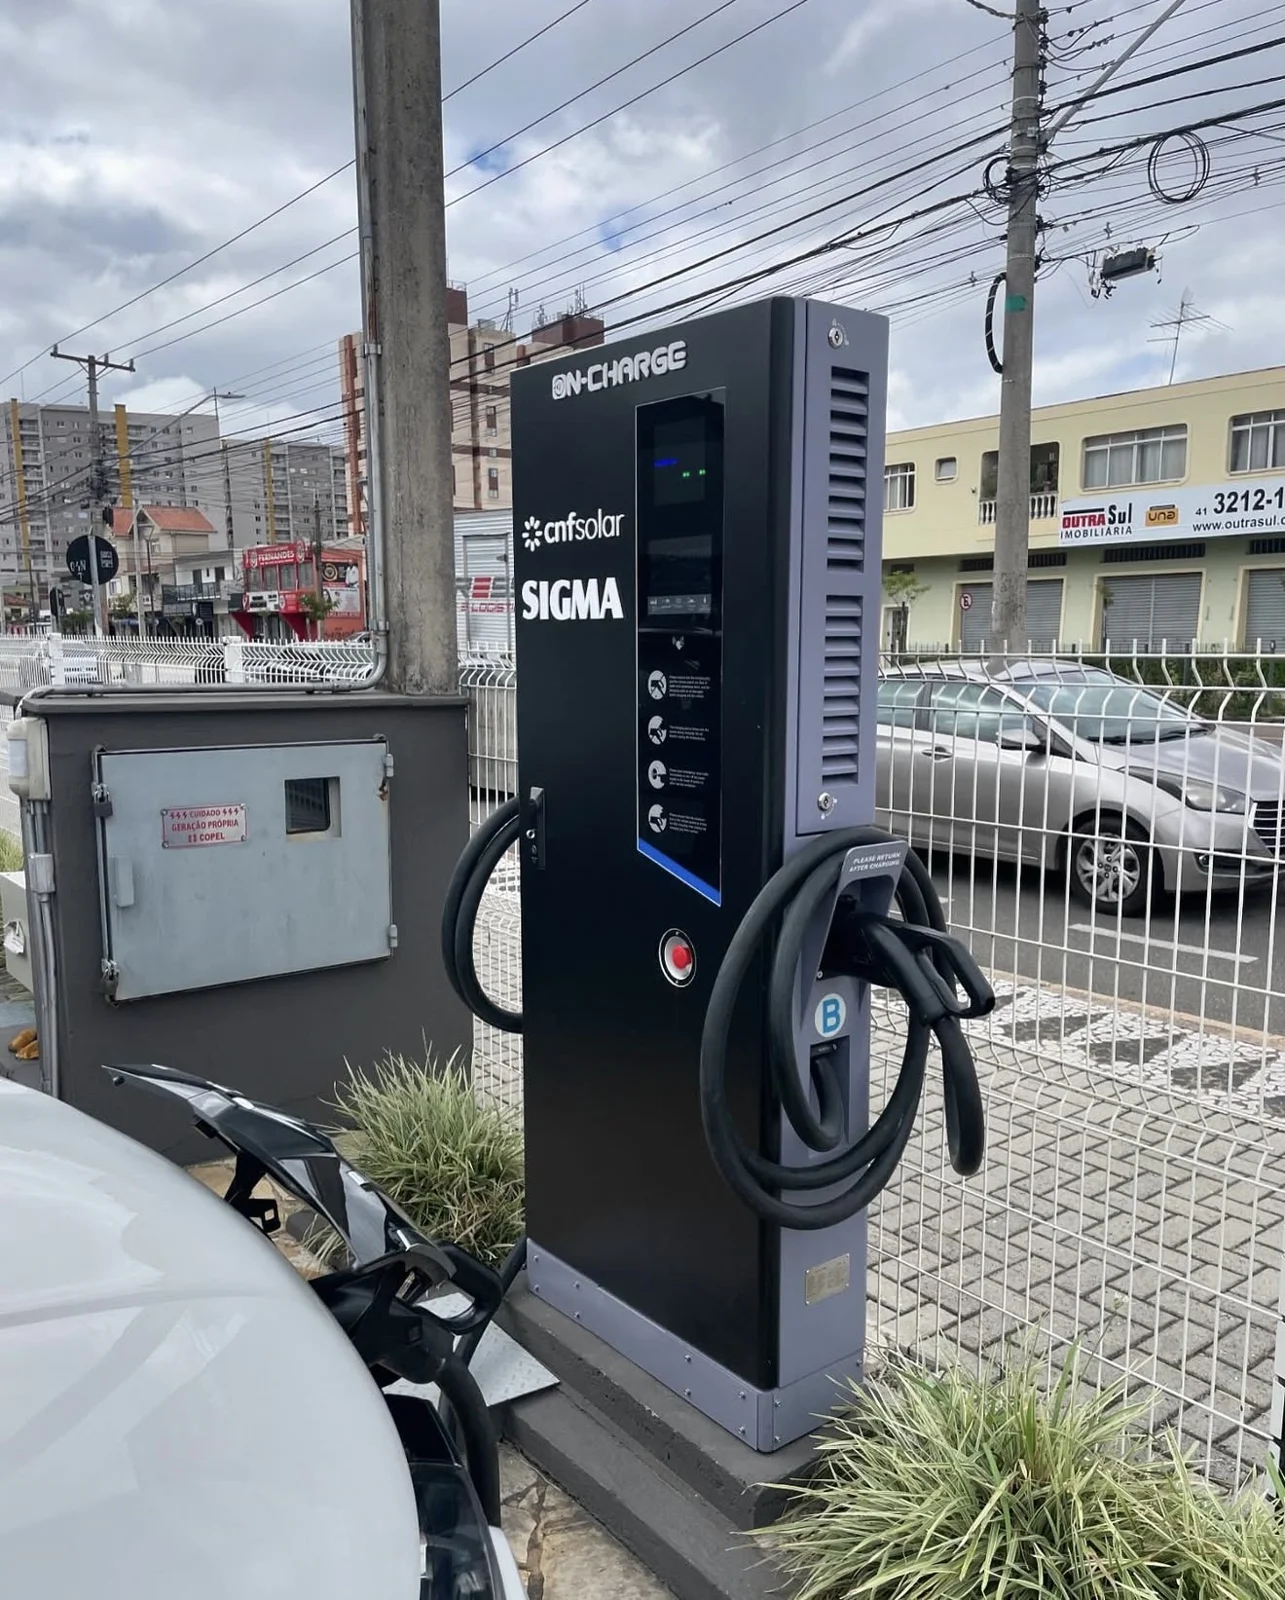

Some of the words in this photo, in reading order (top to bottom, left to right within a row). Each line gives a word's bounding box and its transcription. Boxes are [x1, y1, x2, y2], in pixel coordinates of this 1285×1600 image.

[1195, 507, 1207, 516] 41
[544, 508, 625, 544] cnfsolar
[258, 550, 295, 561] FERNANDES
[521, 577, 624, 621] SIGMA
[189, 809, 221, 818] CUIDADO
[171, 820, 206, 832] GERAÇÃO
[208, 818, 239, 829] PRÓPRIA
[199, 832, 225, 842] COPEL
[853, 855, 876, 865] PLEASE
[877, 852, 901, 861] RETURN
[849, 864, 868, 872] AFTER
[870, 859, 900, 870] CHARGING
[823, 998, 841, 1034] B
